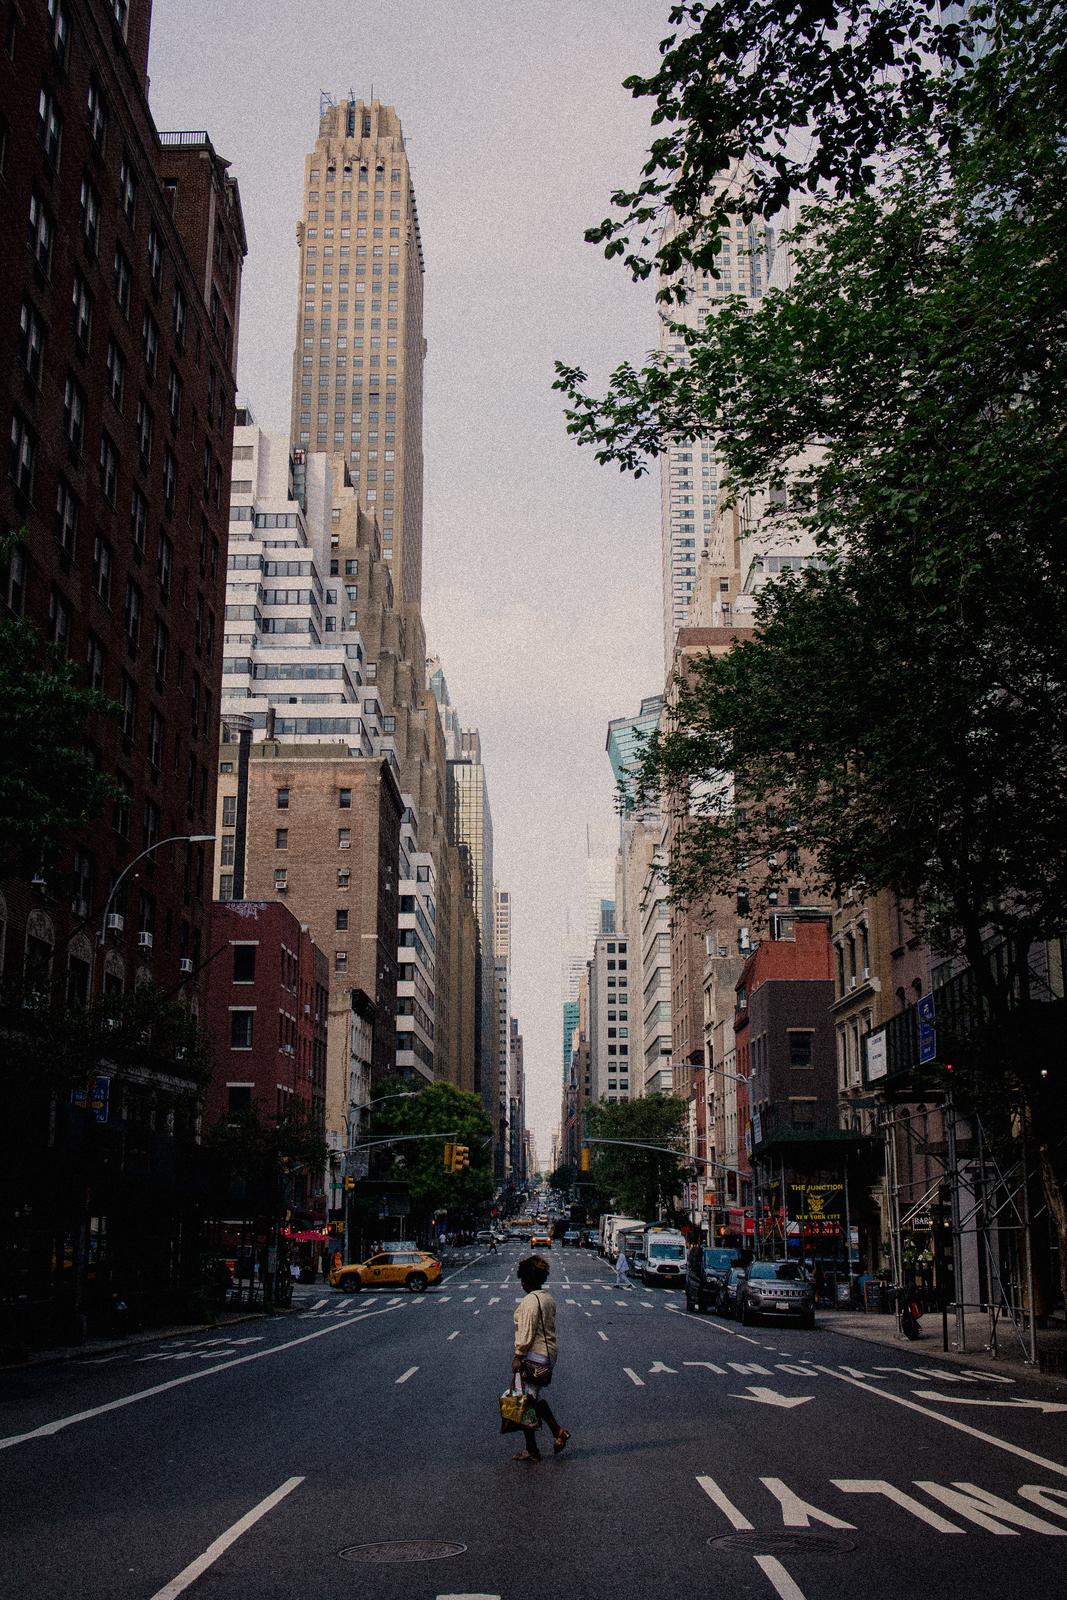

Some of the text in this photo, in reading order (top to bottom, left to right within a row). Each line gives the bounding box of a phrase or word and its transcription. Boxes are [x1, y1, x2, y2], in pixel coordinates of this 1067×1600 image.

[806, 1184, 844, 1193] JUNCTION
[809, 1213, 826, 1221] YORK
[914, 1217, 929, 1225] BAR
[648, 1360, 821, 1377] ONLY
[838, 1365, 1017, 1384] ONLY
